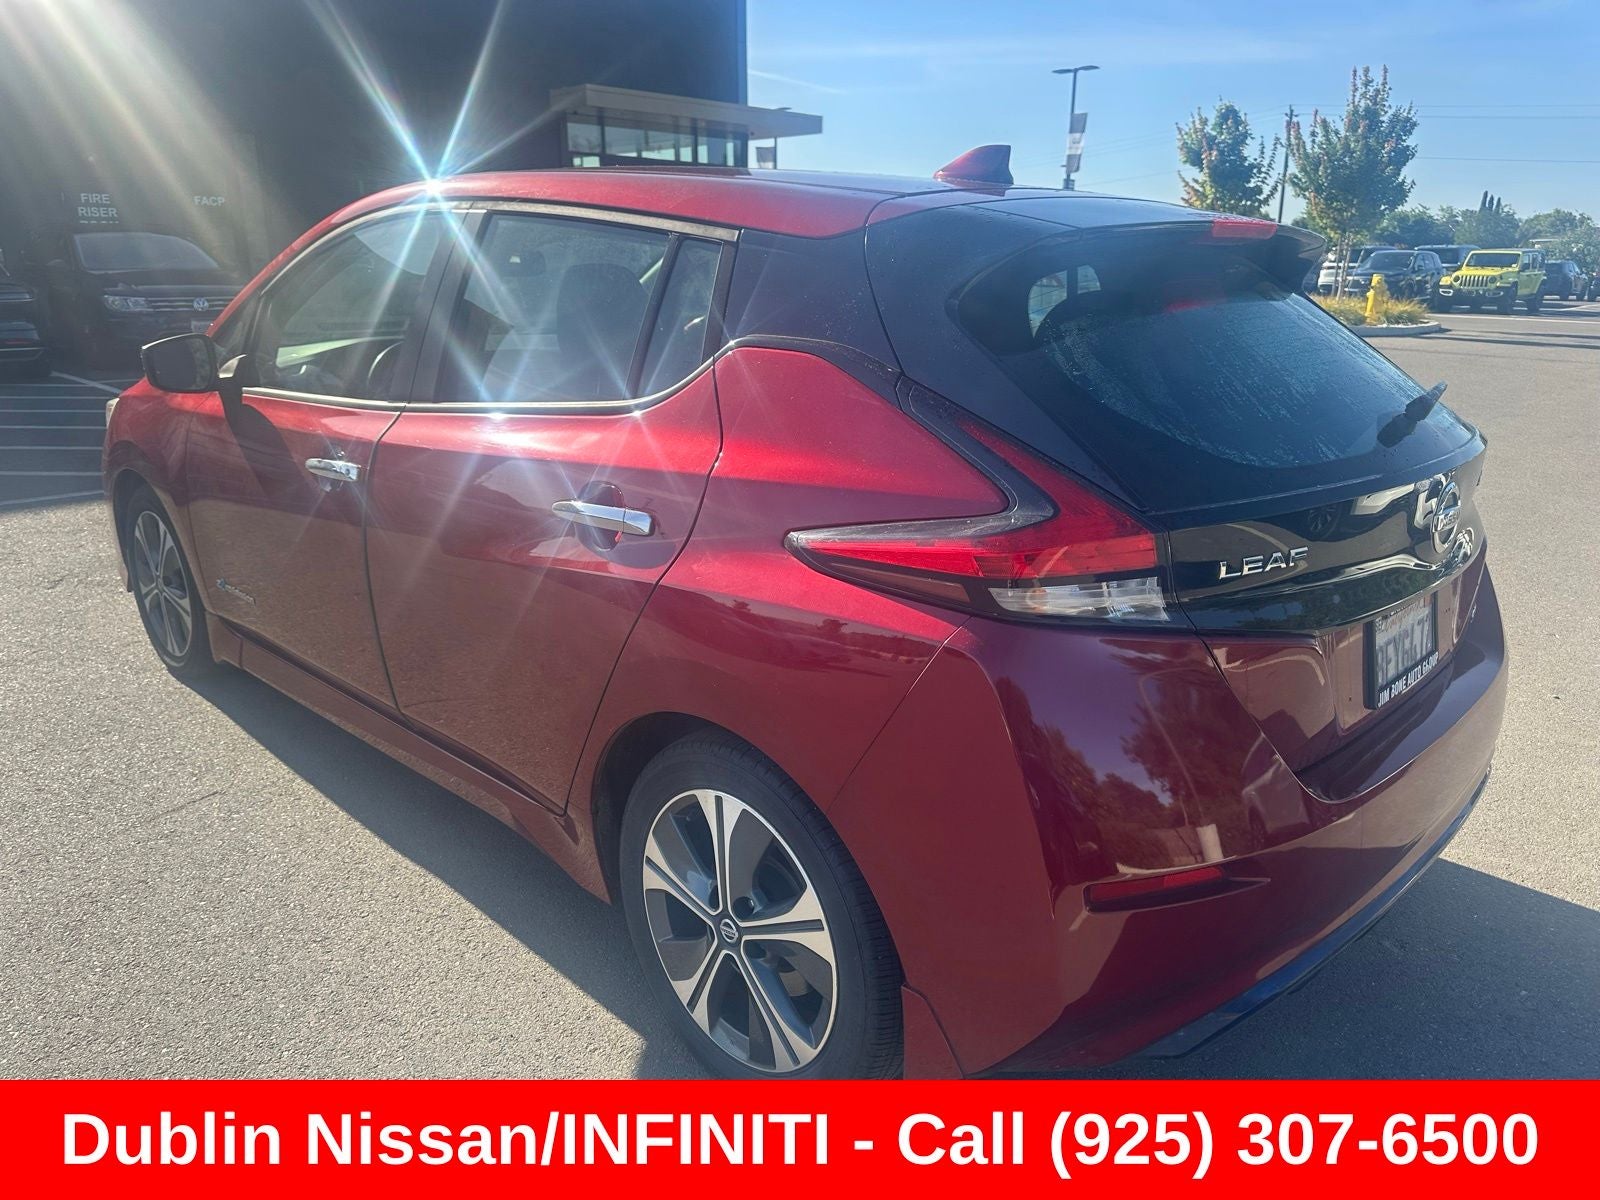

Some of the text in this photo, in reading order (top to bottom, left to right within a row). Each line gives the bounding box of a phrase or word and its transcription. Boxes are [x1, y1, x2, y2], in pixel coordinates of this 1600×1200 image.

[80, 193, 110, 204] FIRE
[193, 195, 225, 207] FACP
[77, 206, 118, 217] RISER
[1218, 546, 1309, 580] LEAF
[1378, 687, 1390, 708] JIM
[1407, 664, 1421, 687] AUTO
